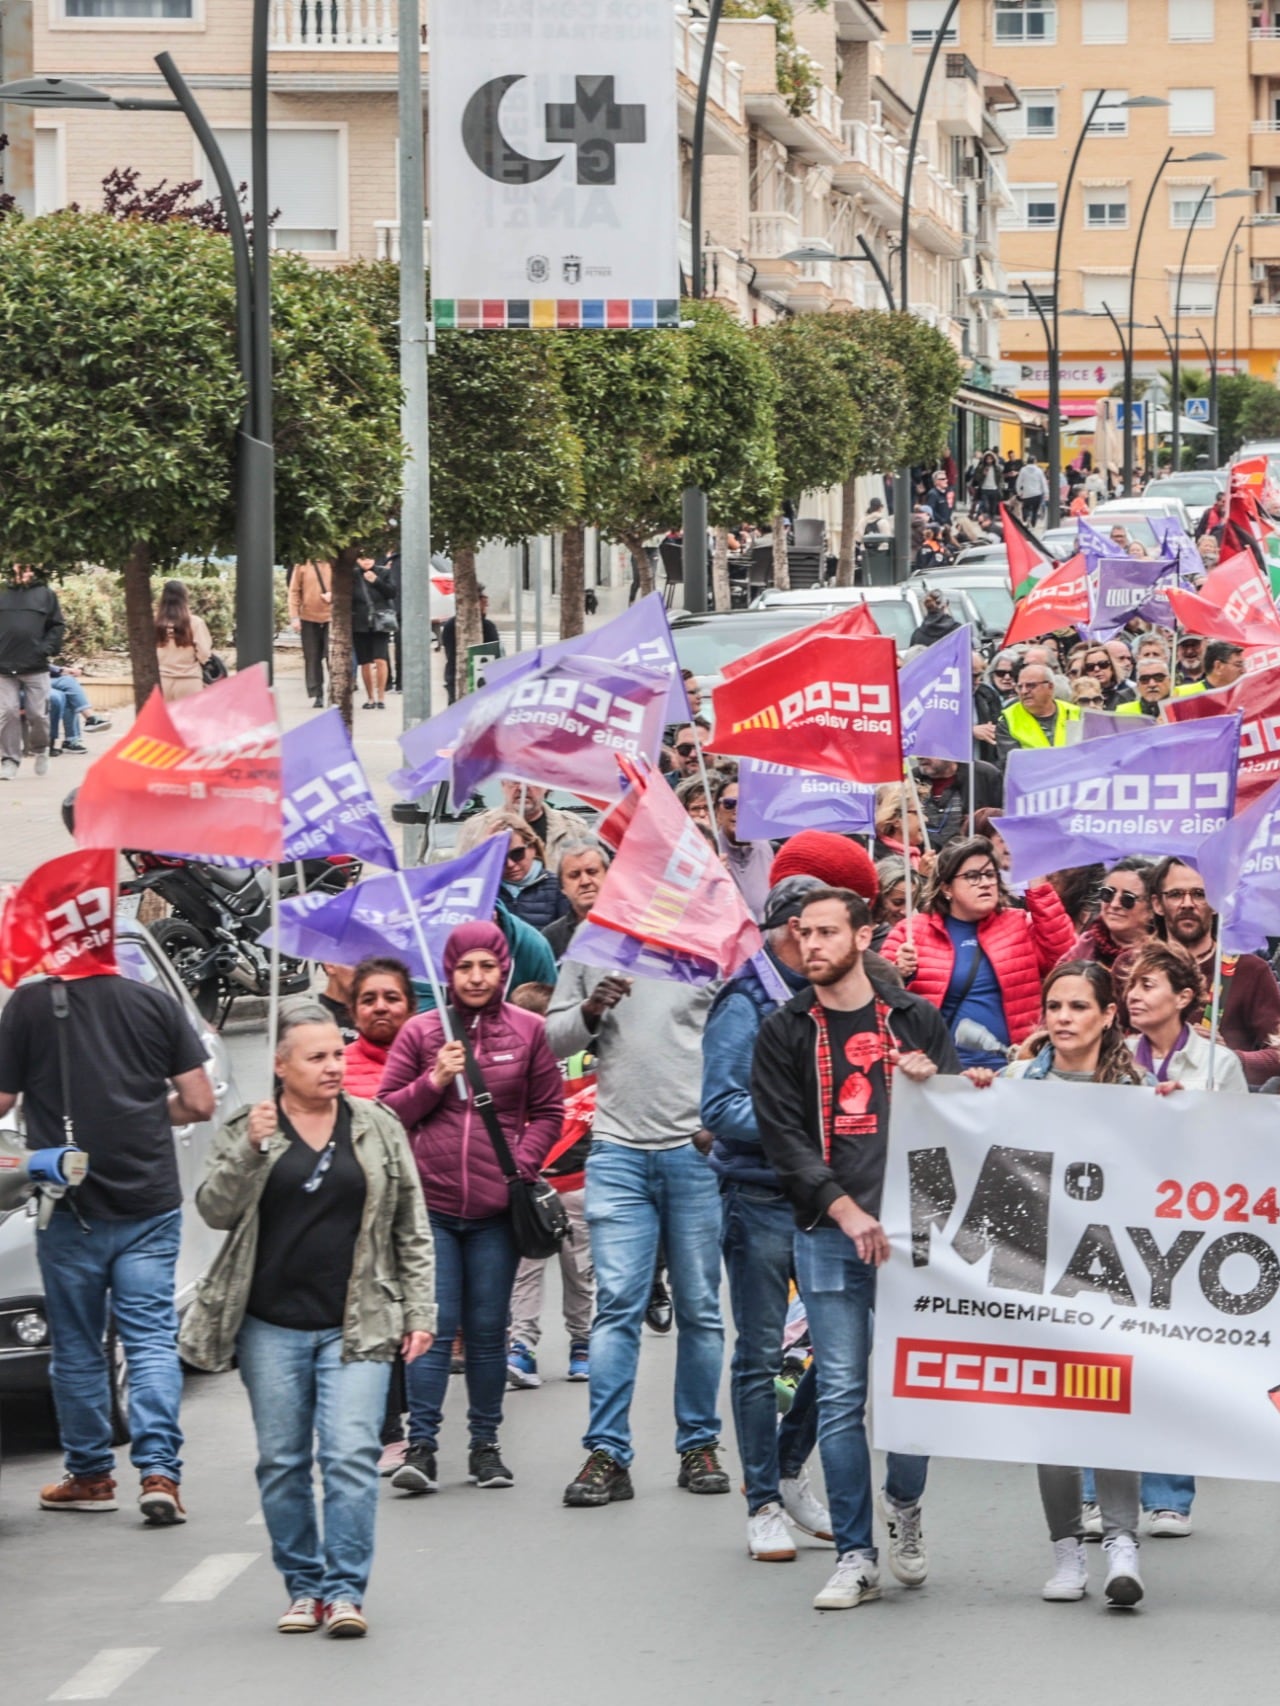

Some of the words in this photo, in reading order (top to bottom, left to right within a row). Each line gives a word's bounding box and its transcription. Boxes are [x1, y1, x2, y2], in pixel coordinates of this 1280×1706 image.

[1155, 1180, 1280, 1225] 2024
[913, 1295, 1095, 1326] #PLENOEMPLEO
[1119, 1317, 1272, 1348] #1MAYO2024
[905, 1350, 1058, 1397] CCOO
